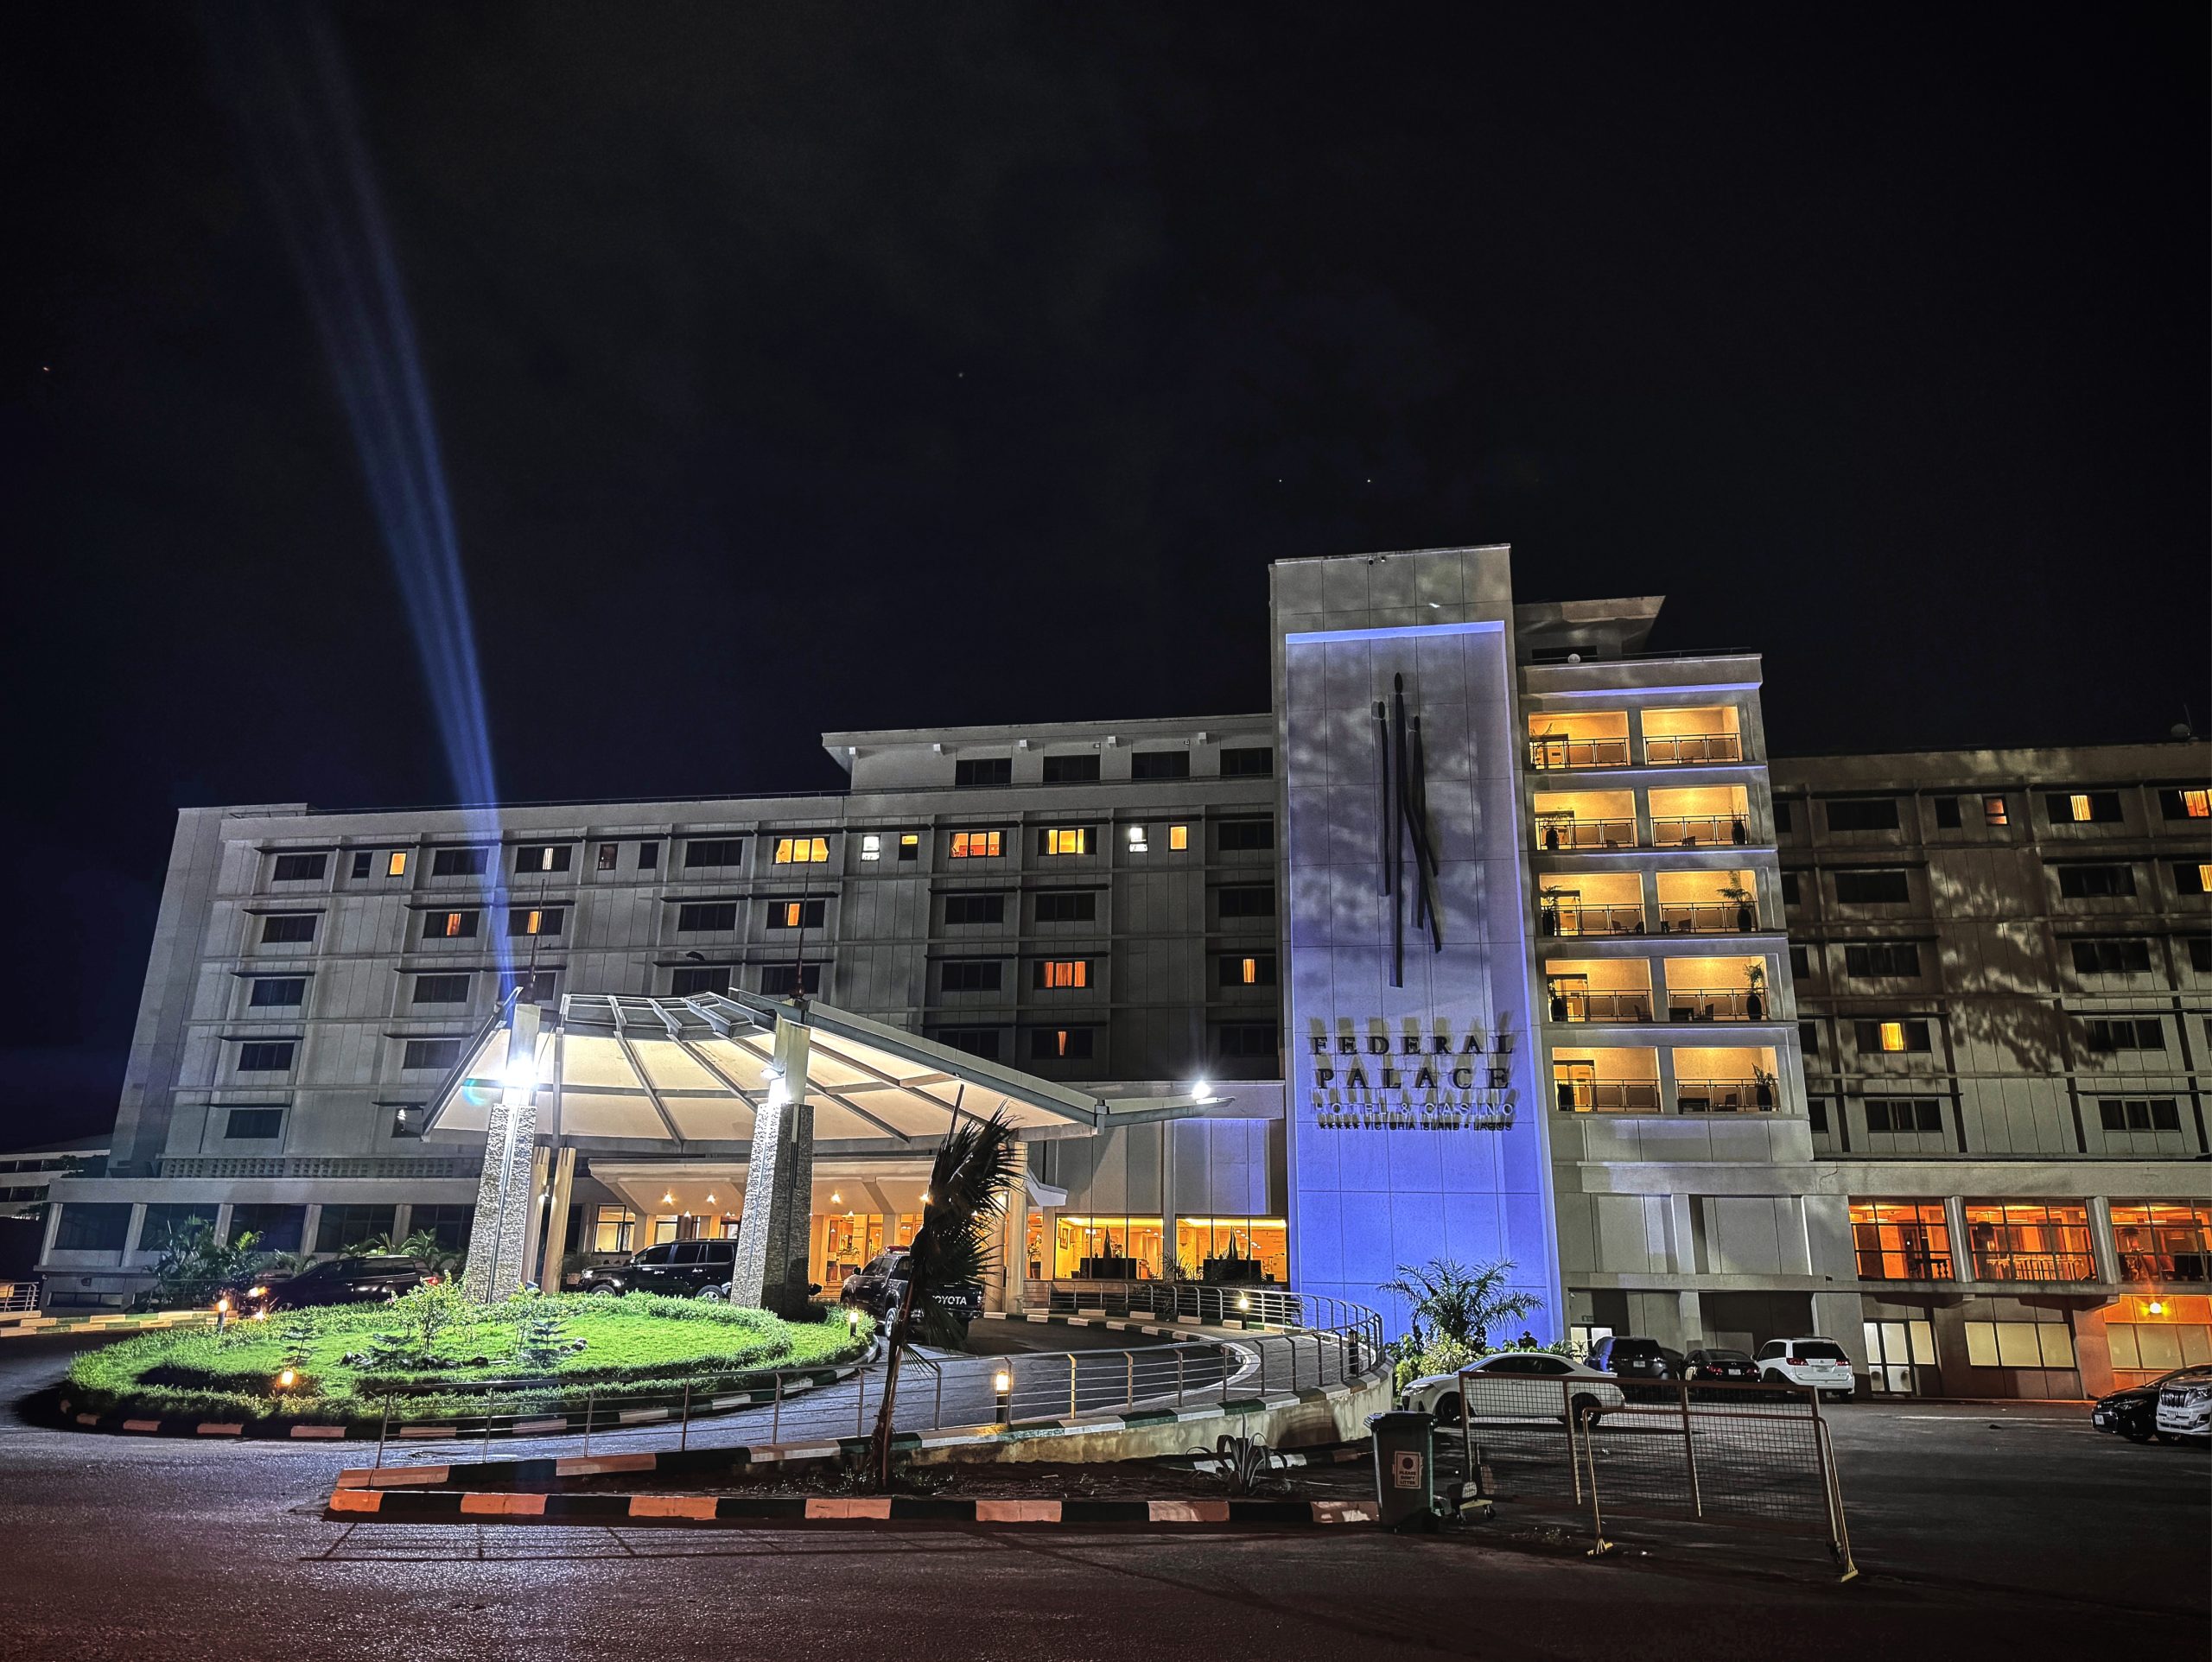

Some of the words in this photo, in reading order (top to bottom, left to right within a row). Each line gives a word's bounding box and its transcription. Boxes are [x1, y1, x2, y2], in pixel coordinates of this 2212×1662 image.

[1310, 1035, 1514, 1056] FEDERAL
[1314, 1068, 1510, 1089] PALACE
[1316, 1102, 1387, 1115] HOTEL
[1401, 1102, 1411, 1115] &
[1424, 1102, 1514, 1116] CASINO
[1364, 1122, 1416, 1131] VICTORIA
[1420, 1122, 1460, 1131] ISLAND
[1473, 1122, 1513, 1132] LAGOS
[932, 1295, 967, 1305] OYOTA
